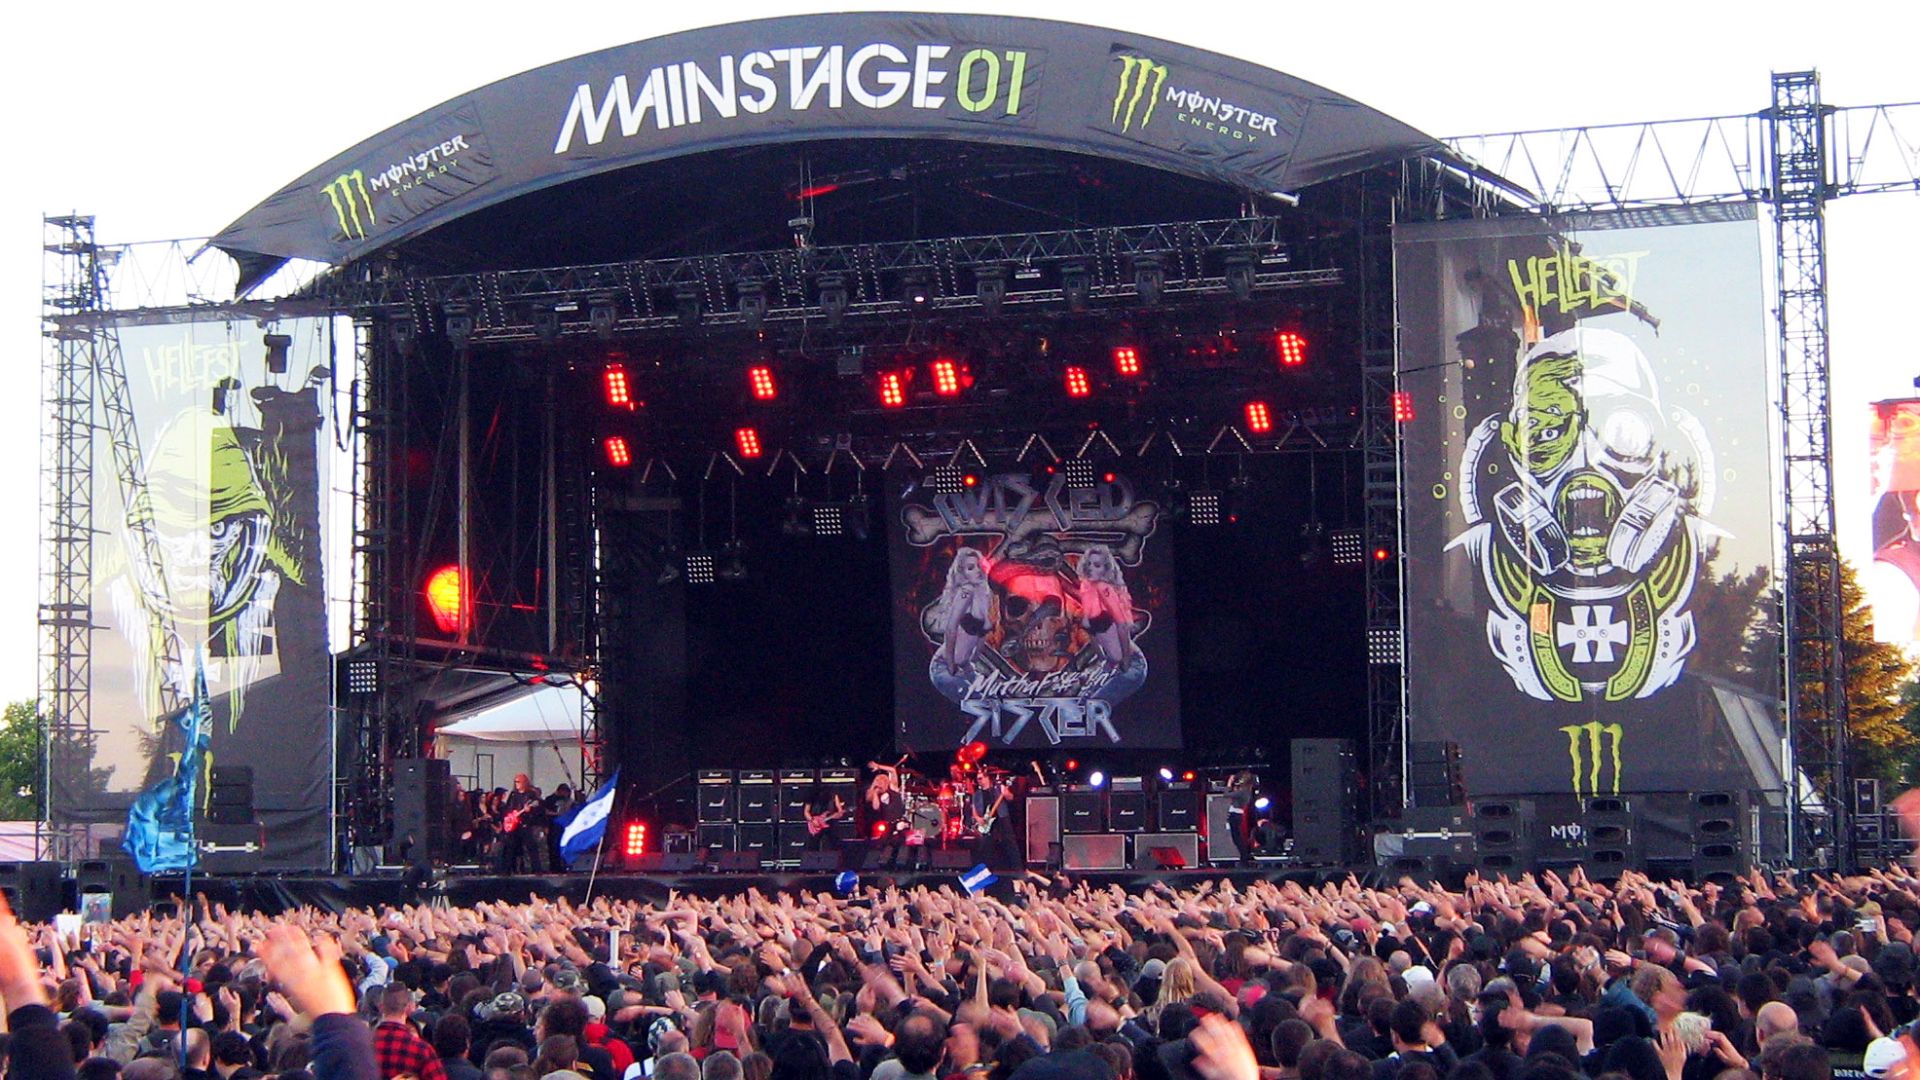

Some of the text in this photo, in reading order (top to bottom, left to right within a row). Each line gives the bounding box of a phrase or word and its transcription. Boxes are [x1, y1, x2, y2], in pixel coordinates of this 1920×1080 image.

[554, 43, 1027, 154] MAINSTAGE 01
[1165, 86, 1278, 137] MONSTER
[1177, 112, 1257, 143] ENERGY
[370, 134, 470, 192] MONSTER
[392, 159, 458, 197] ENERGY
[1507, 240, 1650, 317] HELLFEST
[143, 331, 250, 402] HELLFEST
[960, 697, 1121, 745] SISTER
